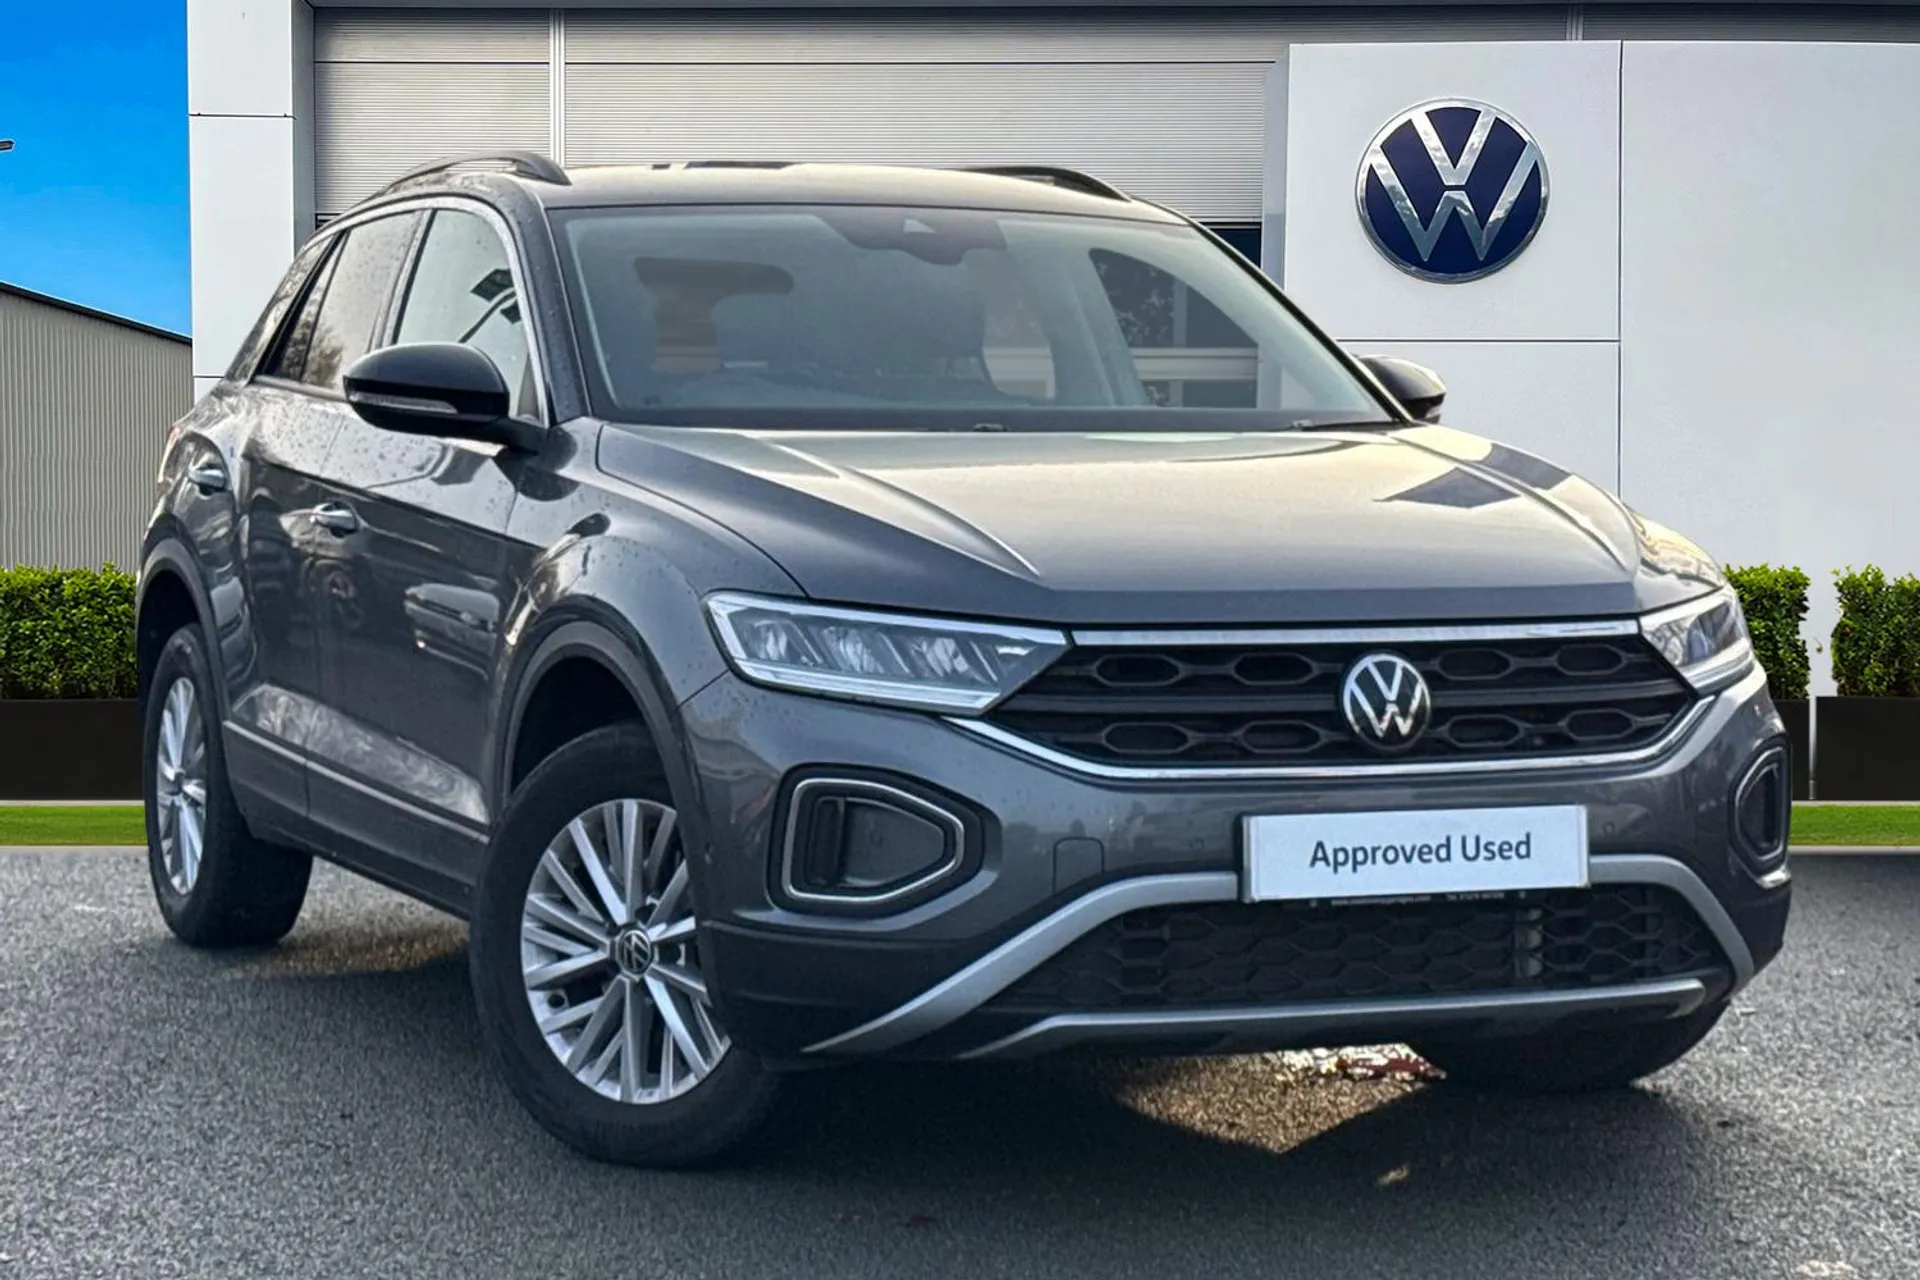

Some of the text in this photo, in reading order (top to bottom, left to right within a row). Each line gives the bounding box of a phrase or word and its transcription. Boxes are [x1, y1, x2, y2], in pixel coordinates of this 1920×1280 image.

[1363, 101, 1542, 263] VW
[1348, 657, 1424, 738] VW
[1309, 832, 1533, 875] Approved Used
